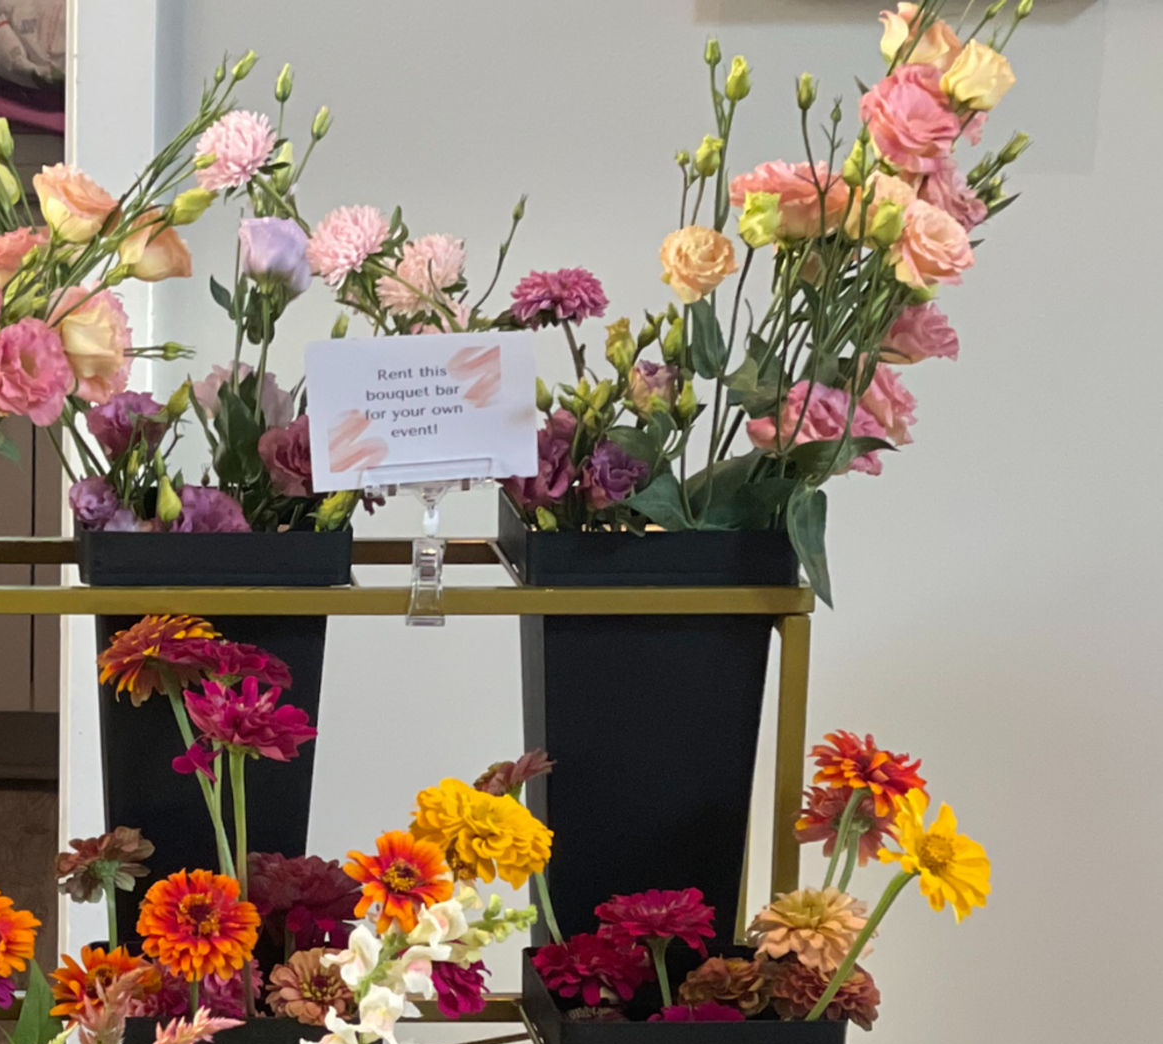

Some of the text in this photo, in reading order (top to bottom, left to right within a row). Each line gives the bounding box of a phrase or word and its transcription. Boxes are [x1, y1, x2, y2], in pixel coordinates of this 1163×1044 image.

[377, 366, 447, 381] Rent this
[366, 383, 460, 402] bouquet bar
[365, 404, 463, 423] for your own
[390, 423, 438, 439] event!
